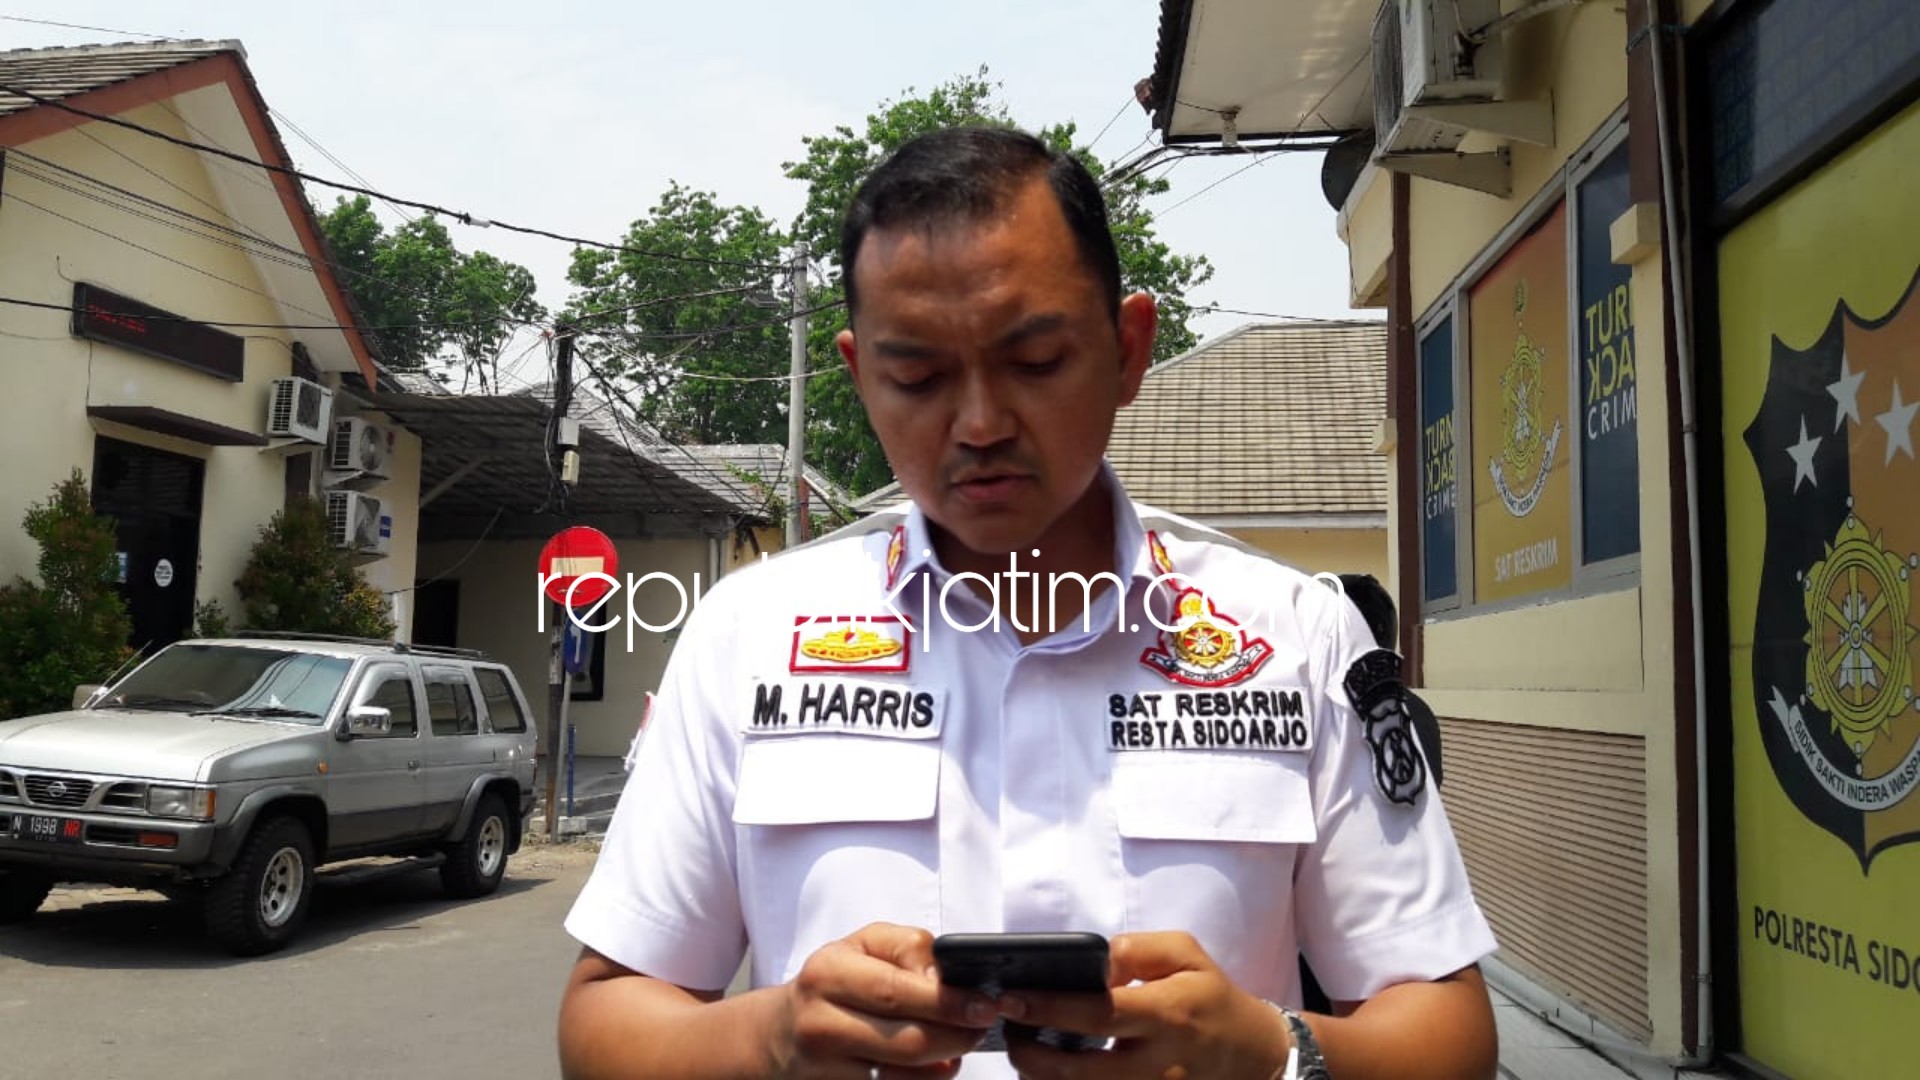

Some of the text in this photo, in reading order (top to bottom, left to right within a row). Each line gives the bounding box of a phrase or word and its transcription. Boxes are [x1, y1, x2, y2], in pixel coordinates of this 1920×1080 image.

[1425, 410, 1455, 460] TURN
[1588, 387, 1636, 440] CRIM
[1514, 537, 1558, 577] RESKRIM
[753, 683, 934, 730] M. HARRIS
[1109, 690, 1303, 718] SAT RESKRIM
[1111, 719, 1307, 747] RESTA SIDOARJO
[1794, 719, 1920, 803] SIDIK SAKTI INDERA WASP
[13, 815, 22, 830] N
[31, 816, 57, 835] 1998
[1754, 905, 1860, 975] POLRESTA
